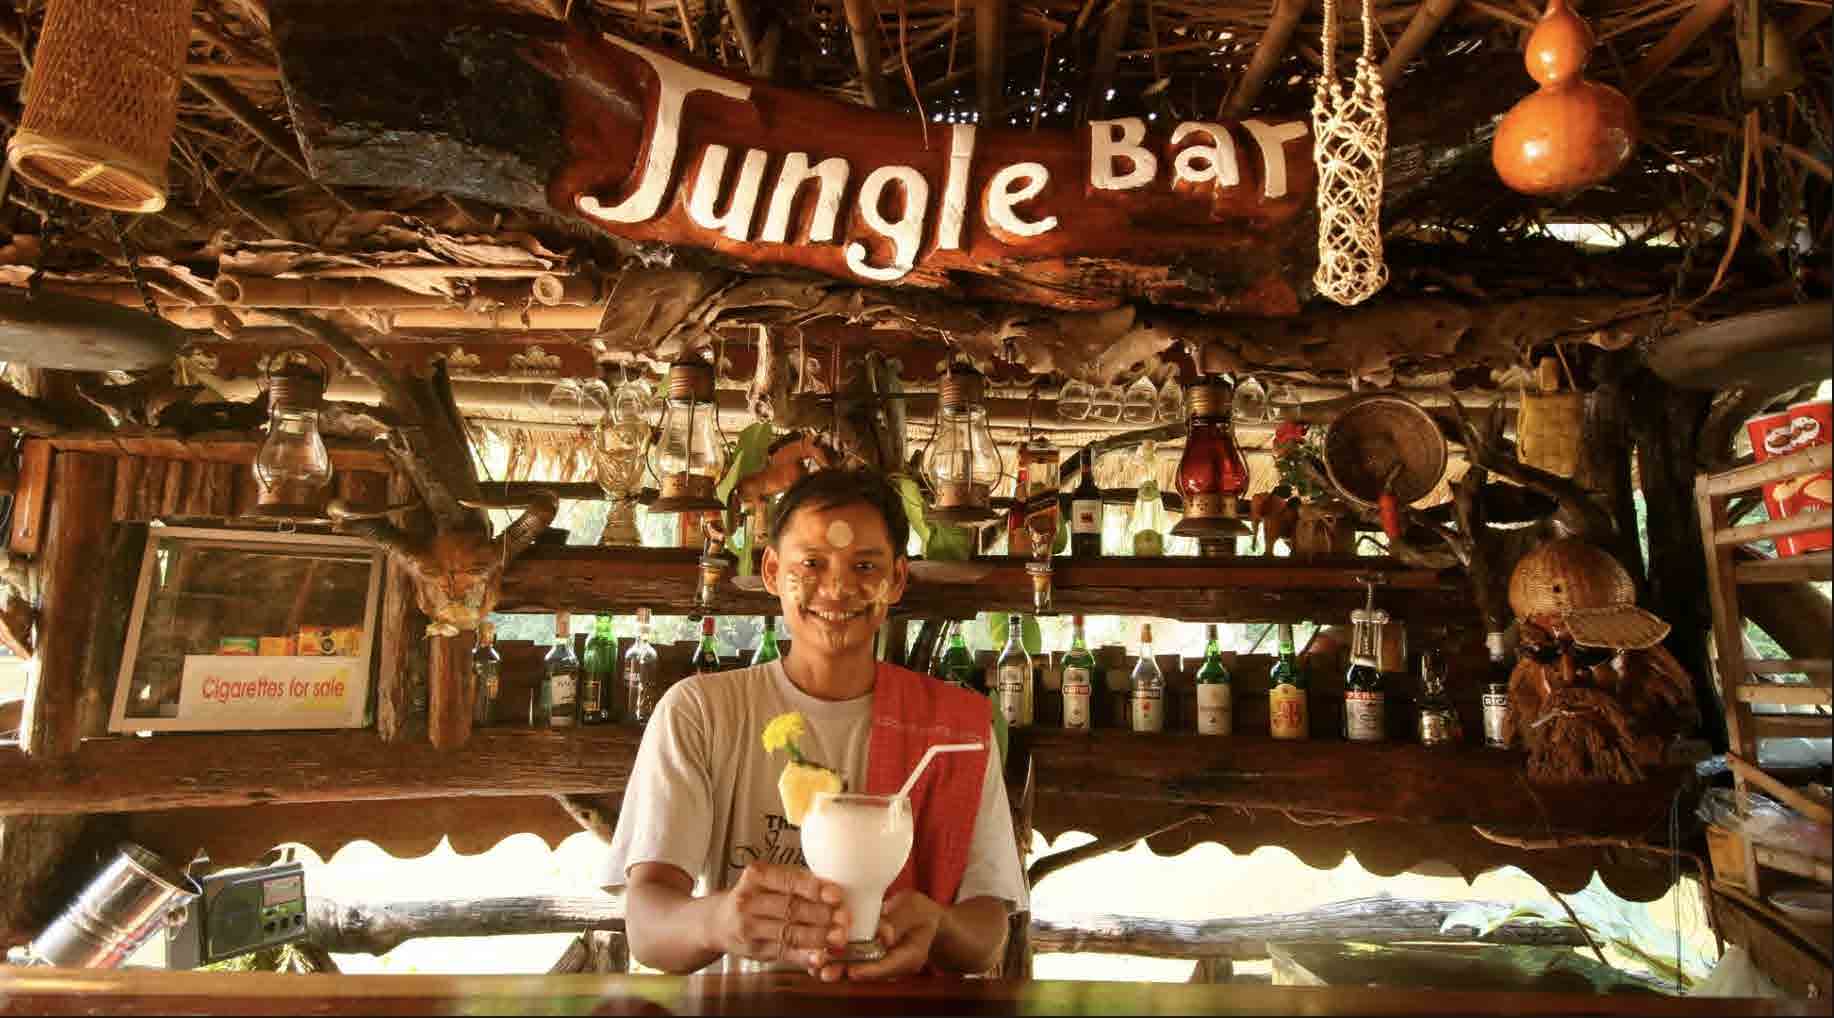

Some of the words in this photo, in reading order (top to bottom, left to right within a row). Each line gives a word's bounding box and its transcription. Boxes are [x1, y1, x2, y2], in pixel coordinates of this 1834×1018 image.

[574, 32, 1058, 282] Jungle
[1089, 117, 1308, 199] Bar
[202, 675, 284, 704] Cigarettes
[288, 676, 311, 697] for
[312, 676, 345, 698] sale
